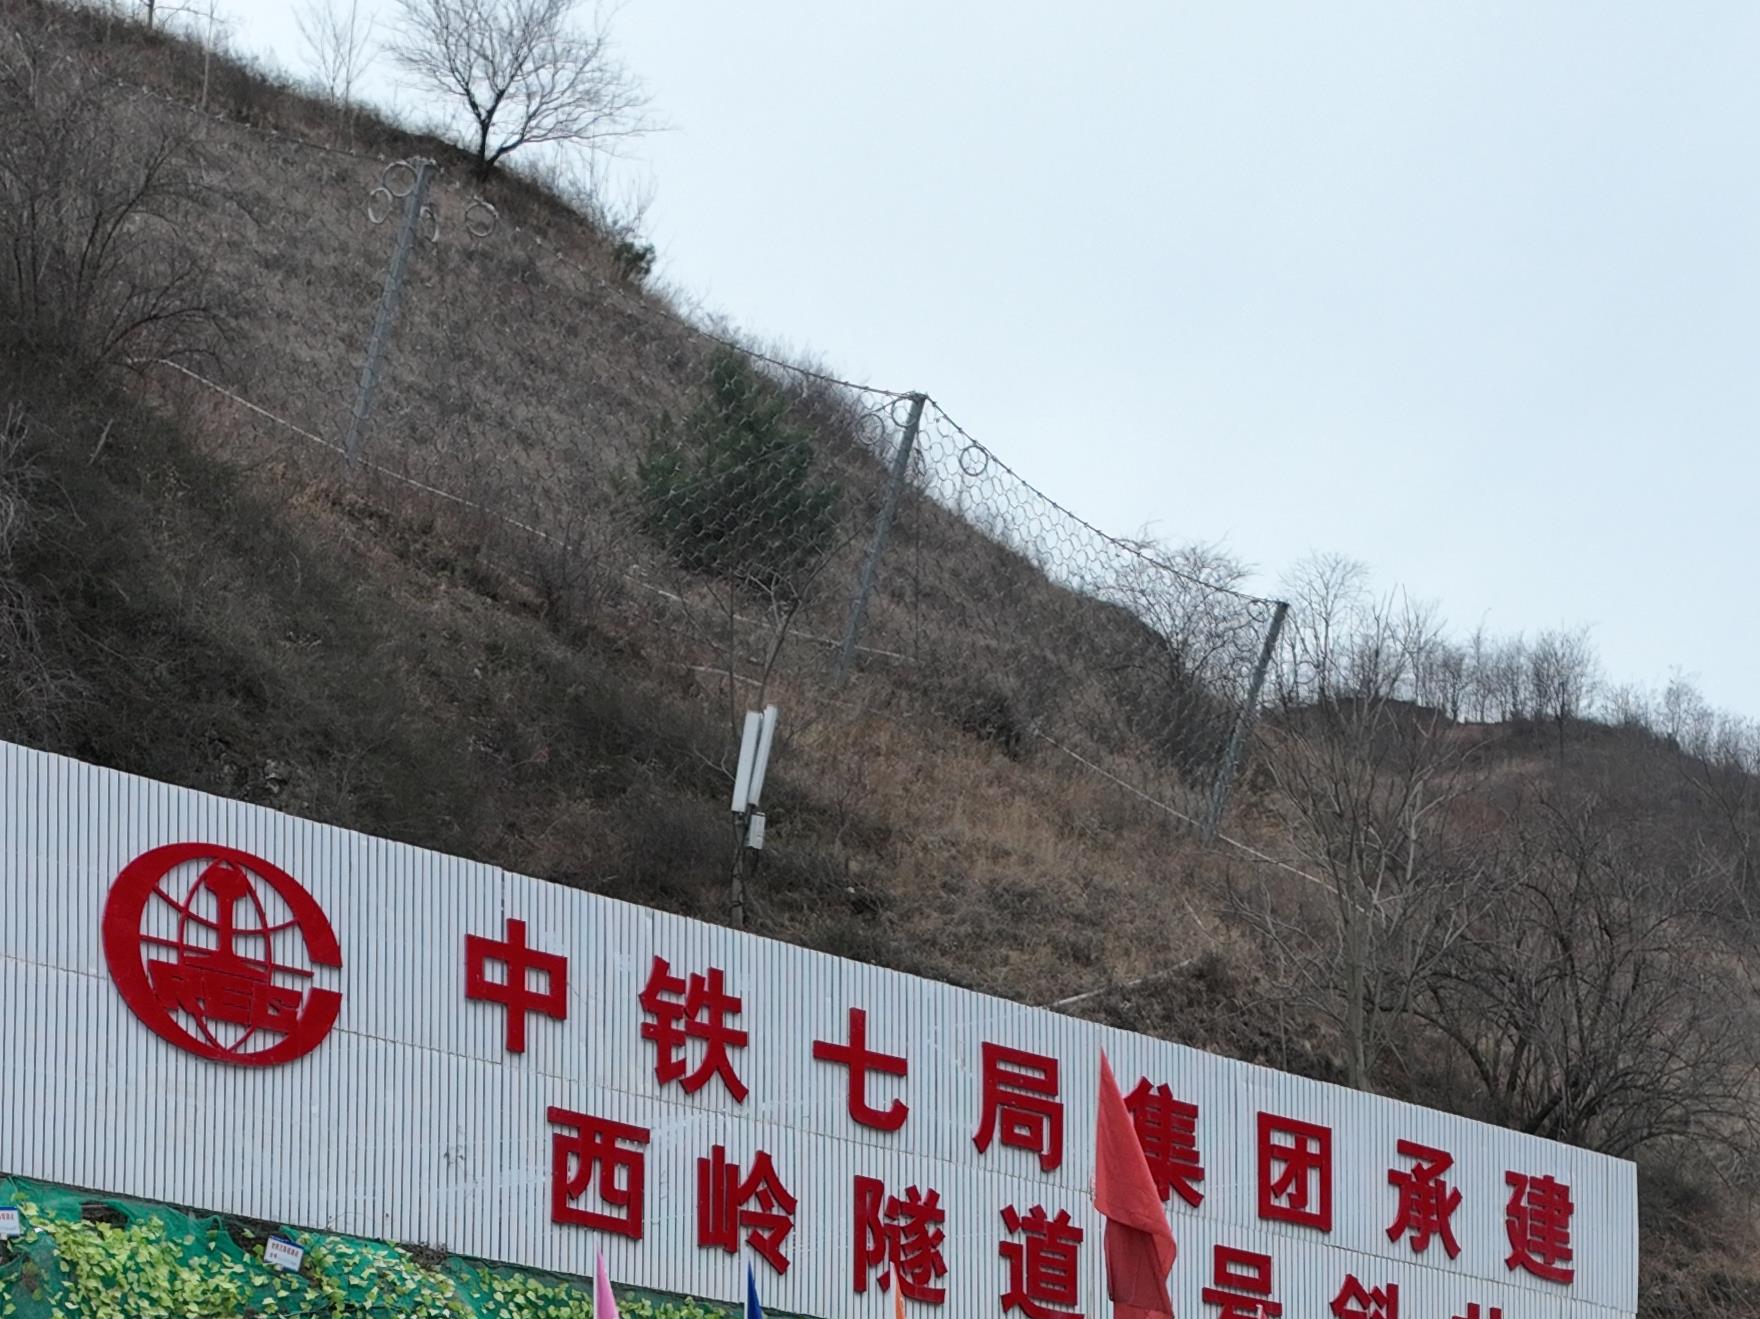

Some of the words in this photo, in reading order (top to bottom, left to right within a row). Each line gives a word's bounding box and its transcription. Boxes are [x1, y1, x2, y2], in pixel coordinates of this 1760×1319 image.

[466, 919, 1574, 1284] 中铁七局集团承建
